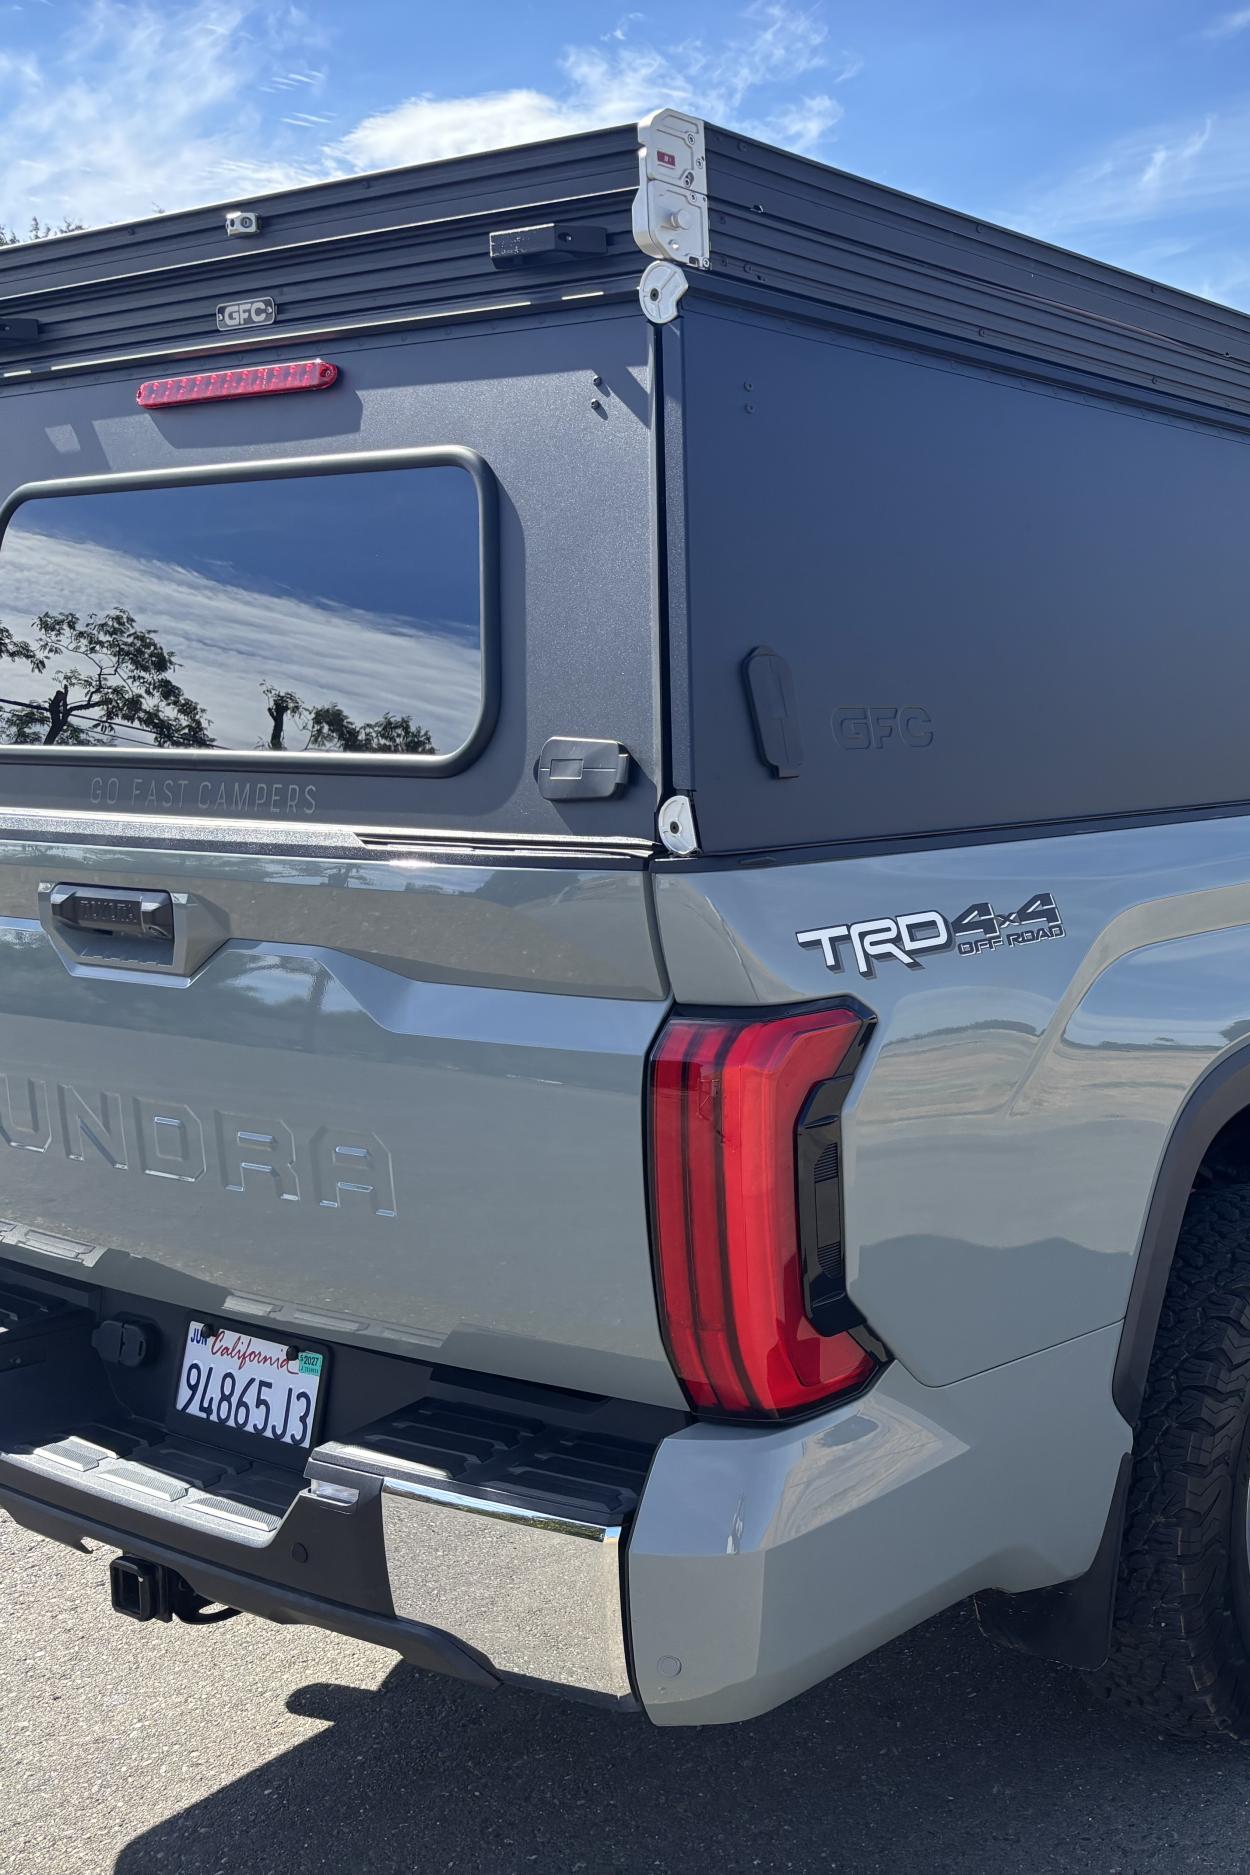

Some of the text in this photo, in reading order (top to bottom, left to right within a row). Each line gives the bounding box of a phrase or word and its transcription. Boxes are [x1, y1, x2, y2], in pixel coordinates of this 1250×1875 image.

[225, 302, 267, 326] GFC
[831, 704, 935, 750] GFC
[90, 777, 317, 814] GO FAST CAMPERS
[795, 909, 956, 980] TRD
[957, 924, 1067, 956] OFF ROAD
[211, 1329, 299, 1375] California
[303, 1354, 319, 1366] 2027
[180, 1362, 312, 1446] 94865J3
